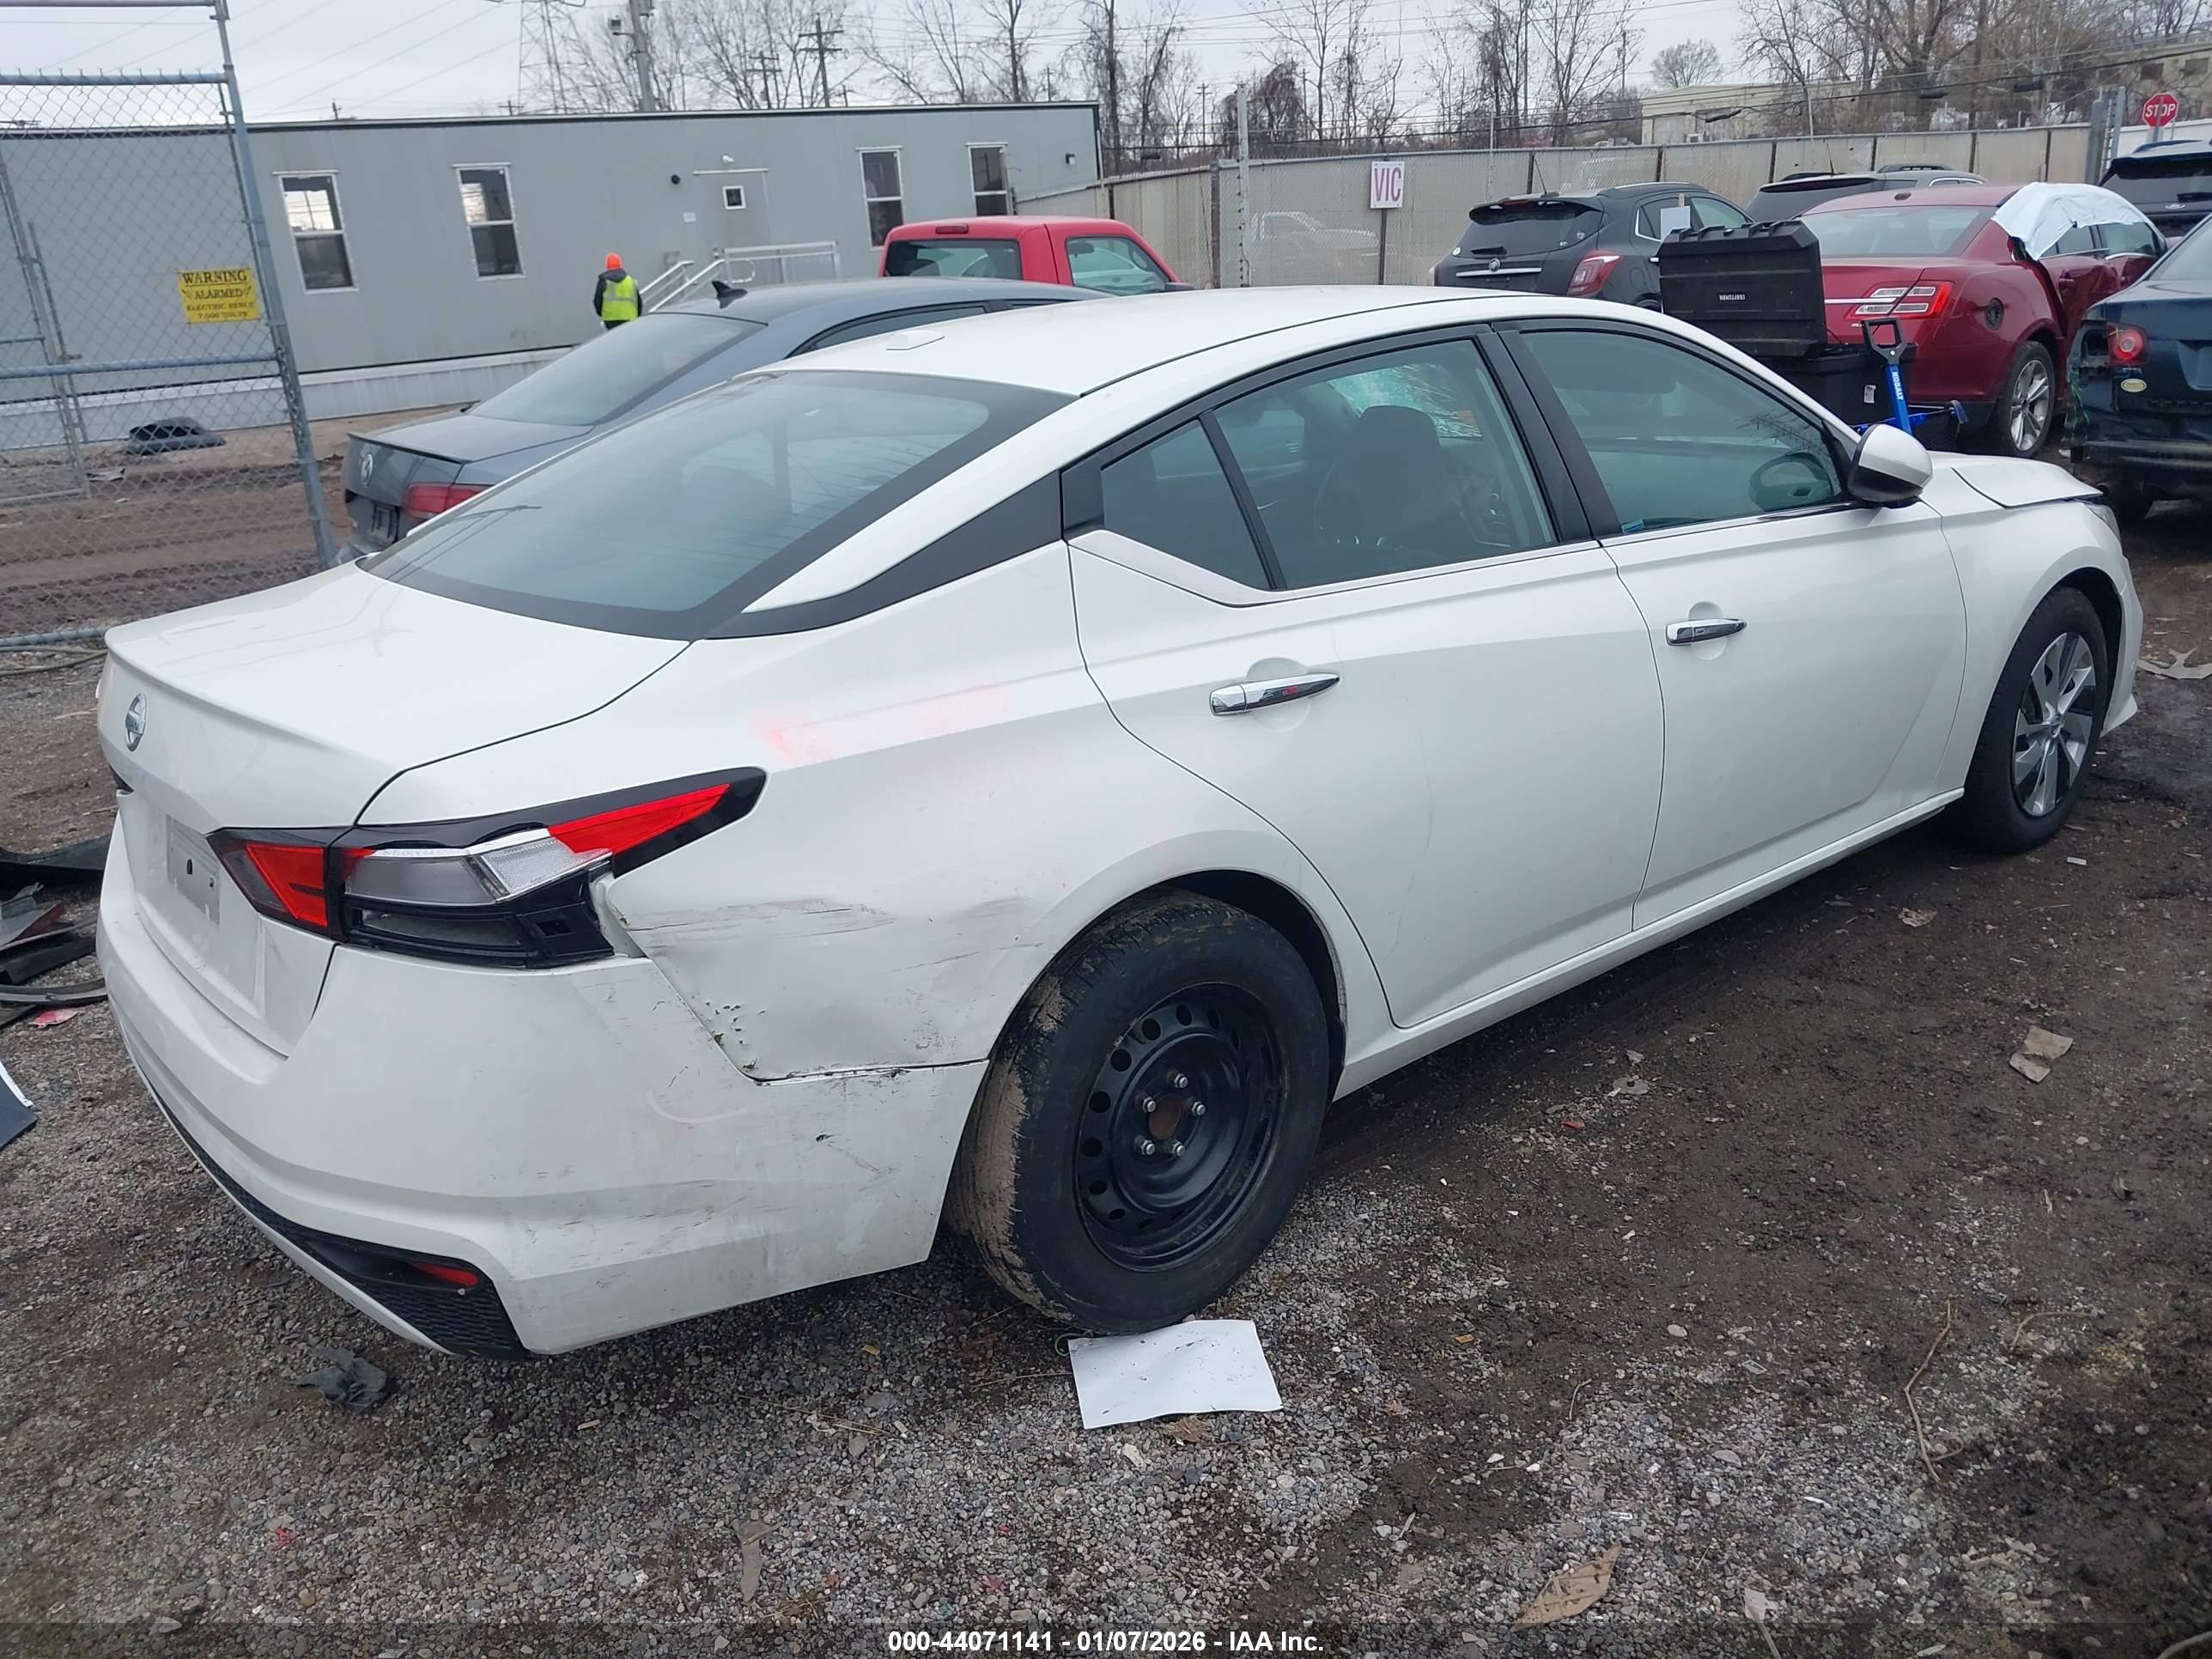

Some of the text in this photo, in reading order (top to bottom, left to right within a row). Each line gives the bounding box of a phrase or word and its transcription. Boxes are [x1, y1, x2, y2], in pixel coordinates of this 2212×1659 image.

[2145, 103, 2176, 118] STOP
[1375, 167, 1401, 202] VIC
[183, 270, 246, 283] WARNING
[195, 289, 243, 299] ALARMED
[1892, 371, 1904, 400] KOBALT
